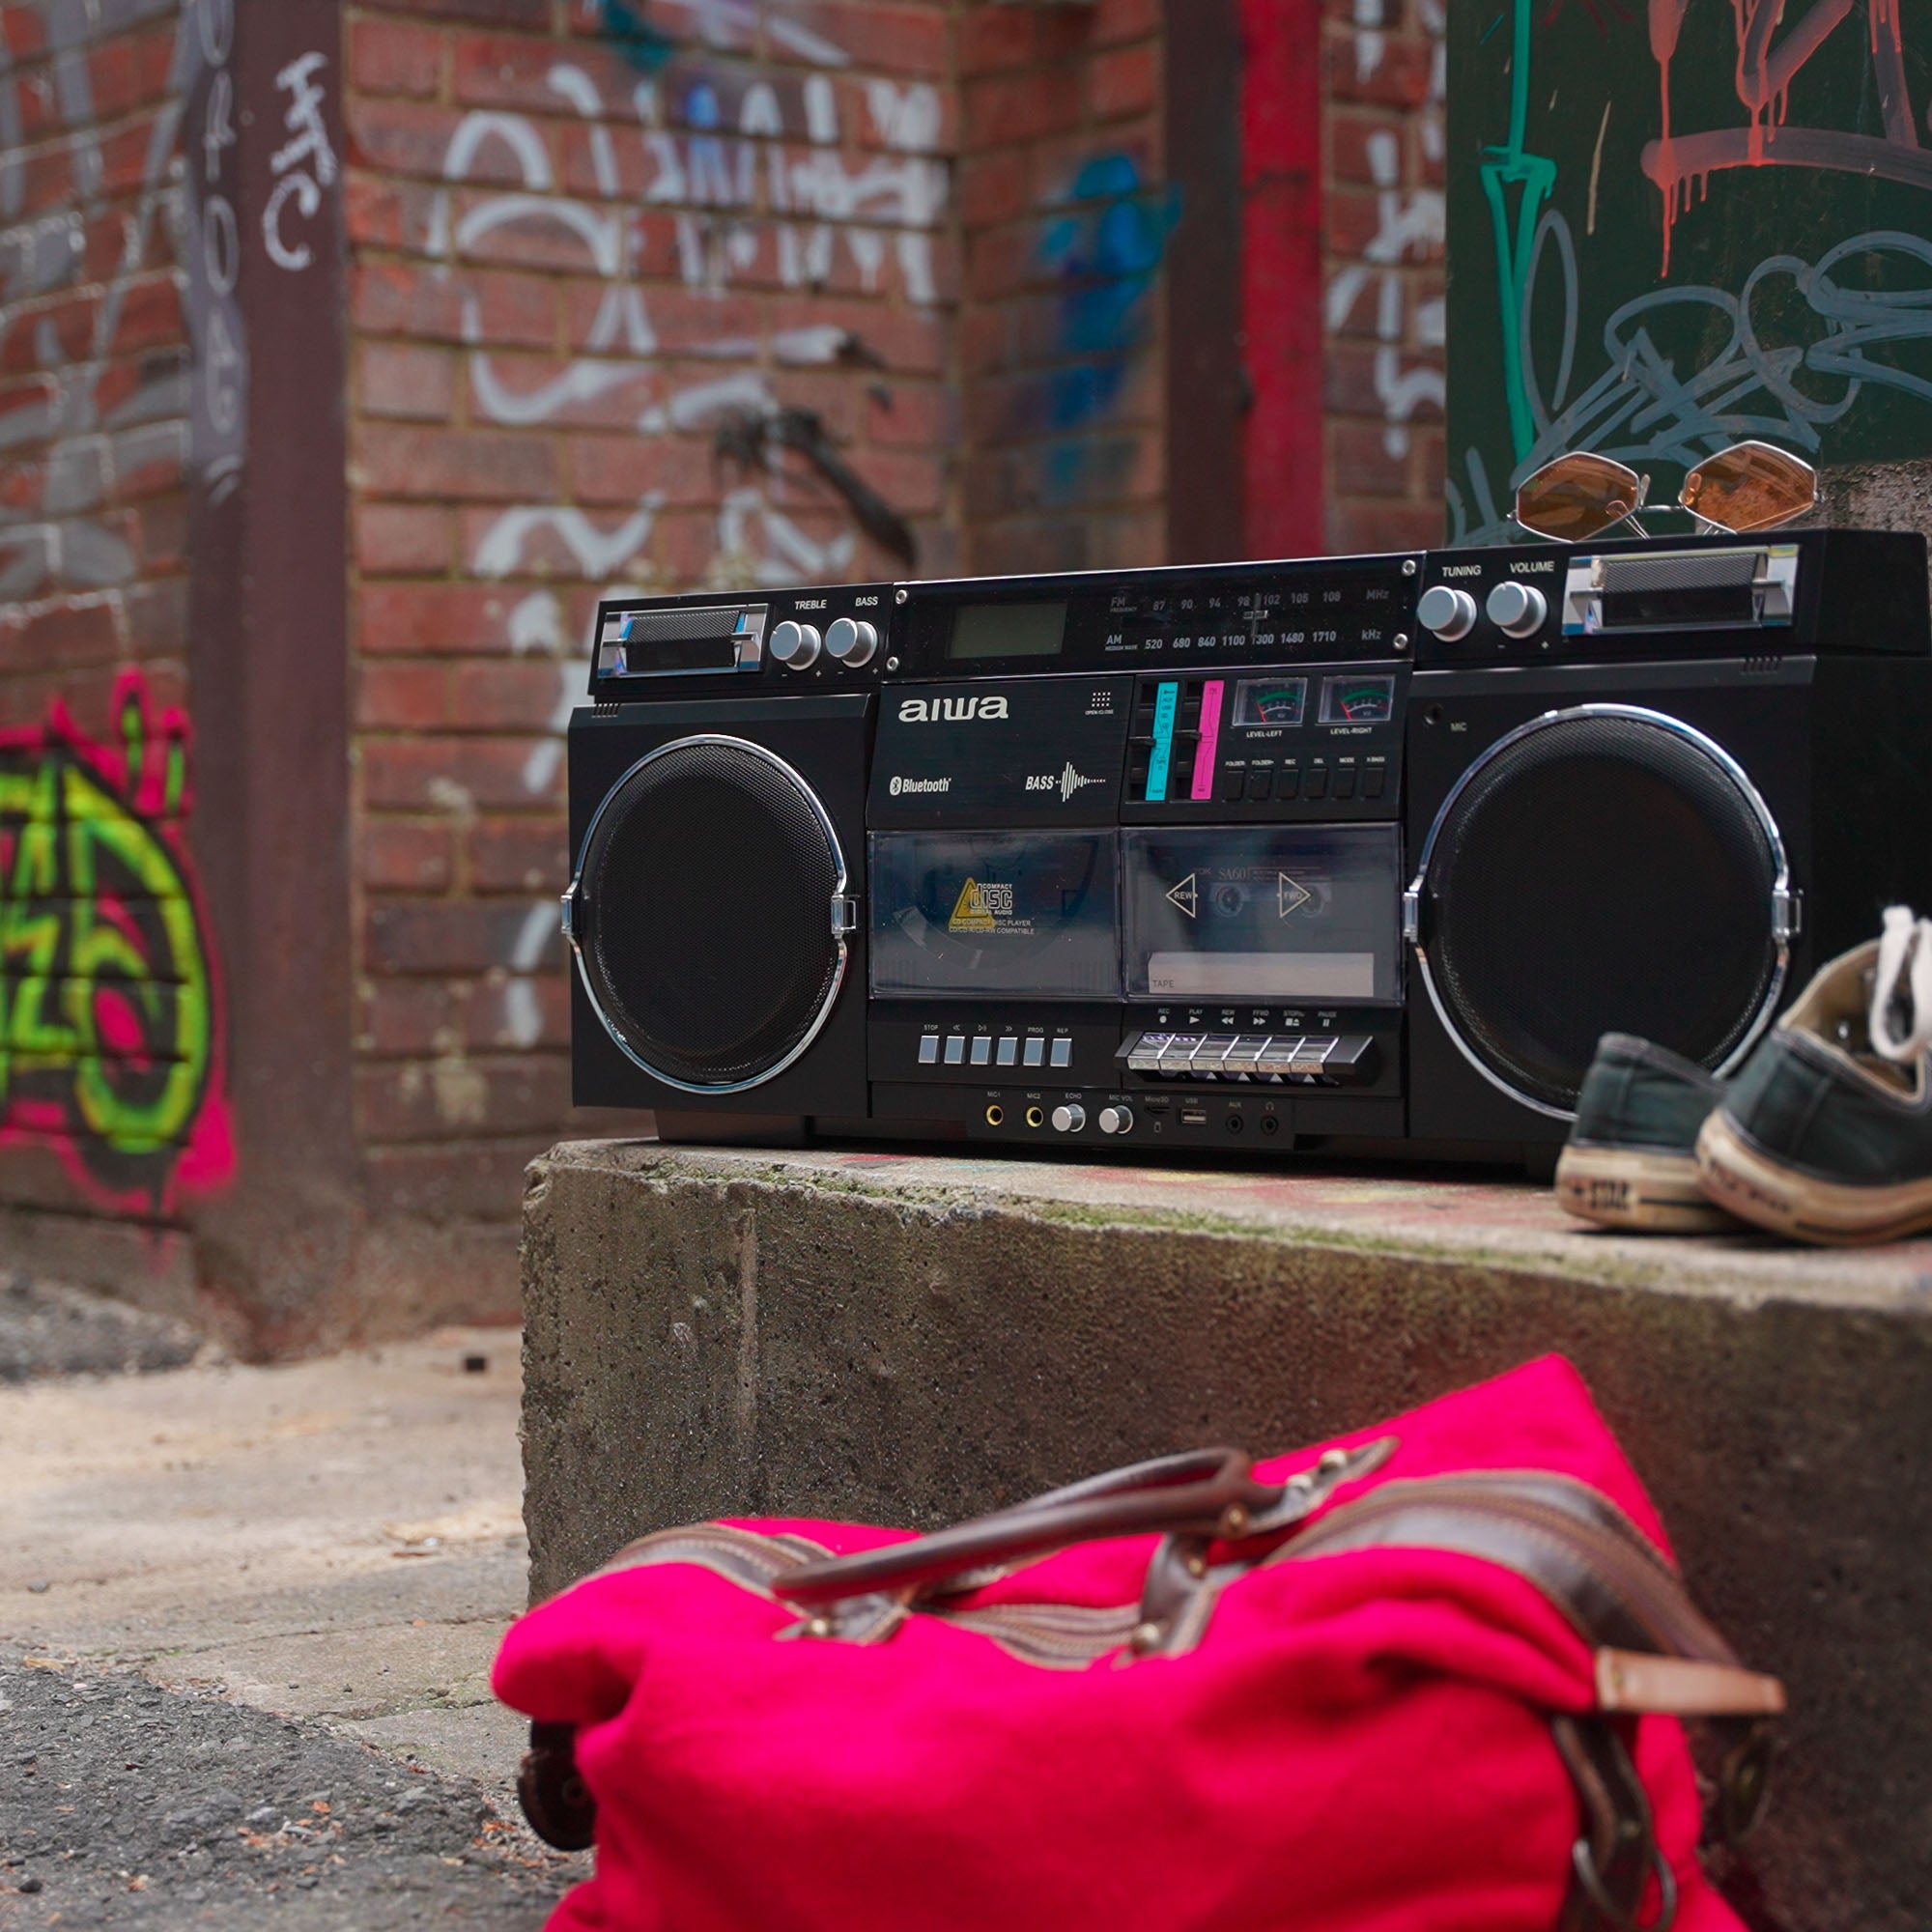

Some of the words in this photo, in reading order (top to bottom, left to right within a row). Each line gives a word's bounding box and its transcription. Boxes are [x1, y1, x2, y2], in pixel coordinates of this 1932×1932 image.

[1442, 565, 1482, 577] TUNING
[1510, 561, 1554, 573] VOLUME
[795, 599, 827, 610] TREBLE
[855, 596, 878, 607] BASS
[1111, 597, 1125, 607] FM
[1152, 601, 1165, 611] 87
[1180, 599, 1193, 610] 90
[1208, 597, 1221, 609] 94
[1237, 596, 1250, 607] 98
[1264, 594, 1281, 606] 102
[1291, 592, 1309, 604] 105
[1322, 590, 1342, 603] 108
[1366, 588, 1389, 600] MHz
[1106, 634, 1122, 644] AM
[1146, 639, 1163, 649] 520
[1173, 638, 1191, 648] 680
[1198, 637, 1216, 647] 840
[1222, 635, 1246, 646] 1100
[1281, 632, 1305, 643] 1480
[1313, 630, 1337, 642] 1710
[1361, 629, 1381, 640] kHz
[1330, 726, 1373, 735] LEVEL-RIGHT
[902, 777, 951, 793] Bluetooth
[1025, 776, 1054, 790] BASS
[1174, 891, 1193, 900] REW
[1152, 980, 1175, 988] TAPE
